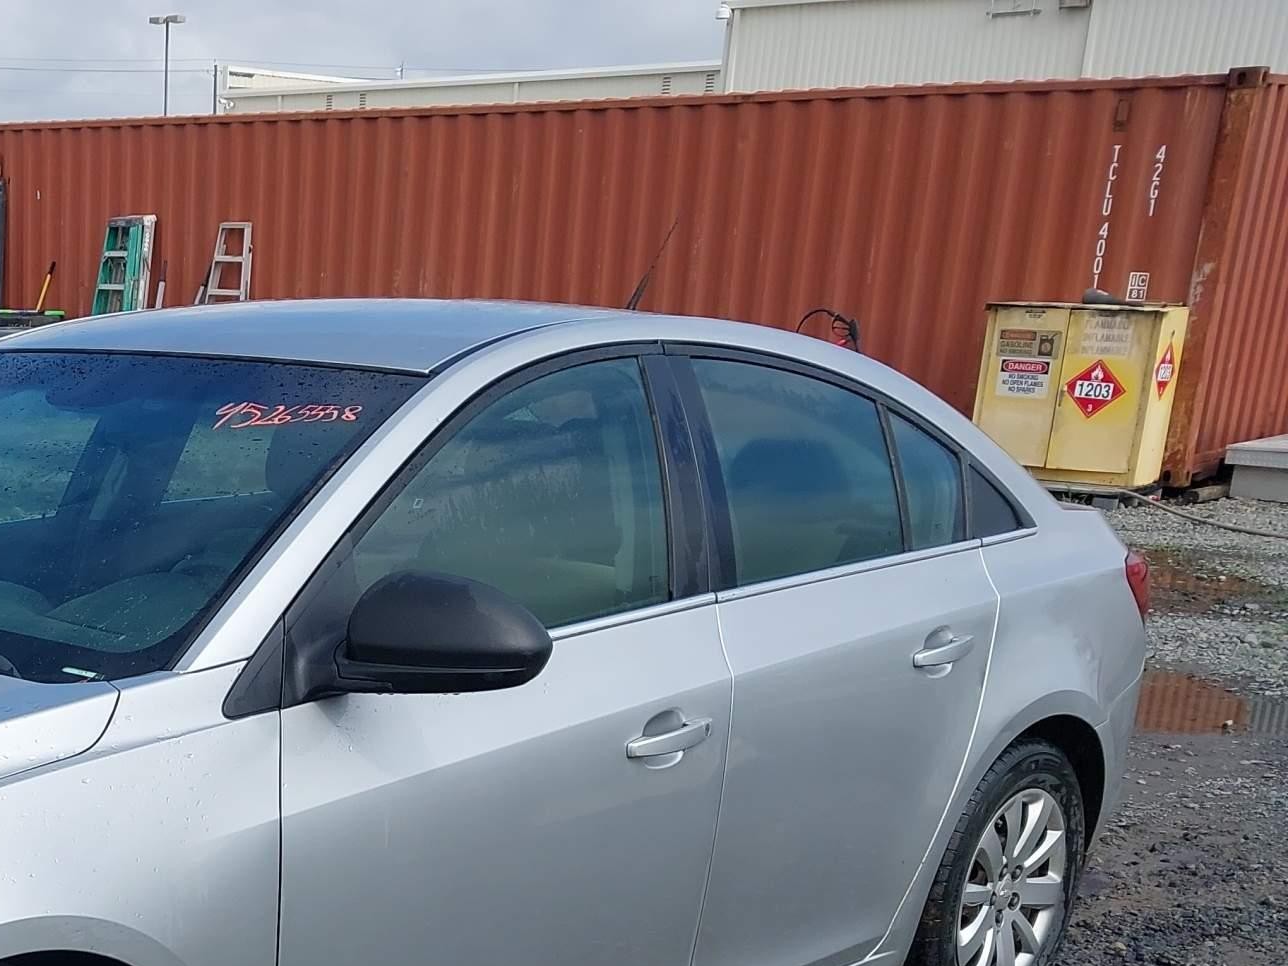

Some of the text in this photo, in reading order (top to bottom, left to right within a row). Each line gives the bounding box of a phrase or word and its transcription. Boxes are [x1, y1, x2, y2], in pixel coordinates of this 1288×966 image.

[1102, 144, 1122, 216] TCLU
[1148, 144, 1167, 217] 42G1
[1130, 289, 1144, 298] 81
[1008, 362, 1043, 371] DANGER
[1077, 382, 1112, 399] 1203
[212, 401, 363, 431] 45265558
[1087, 404, 1093, 412] 3
